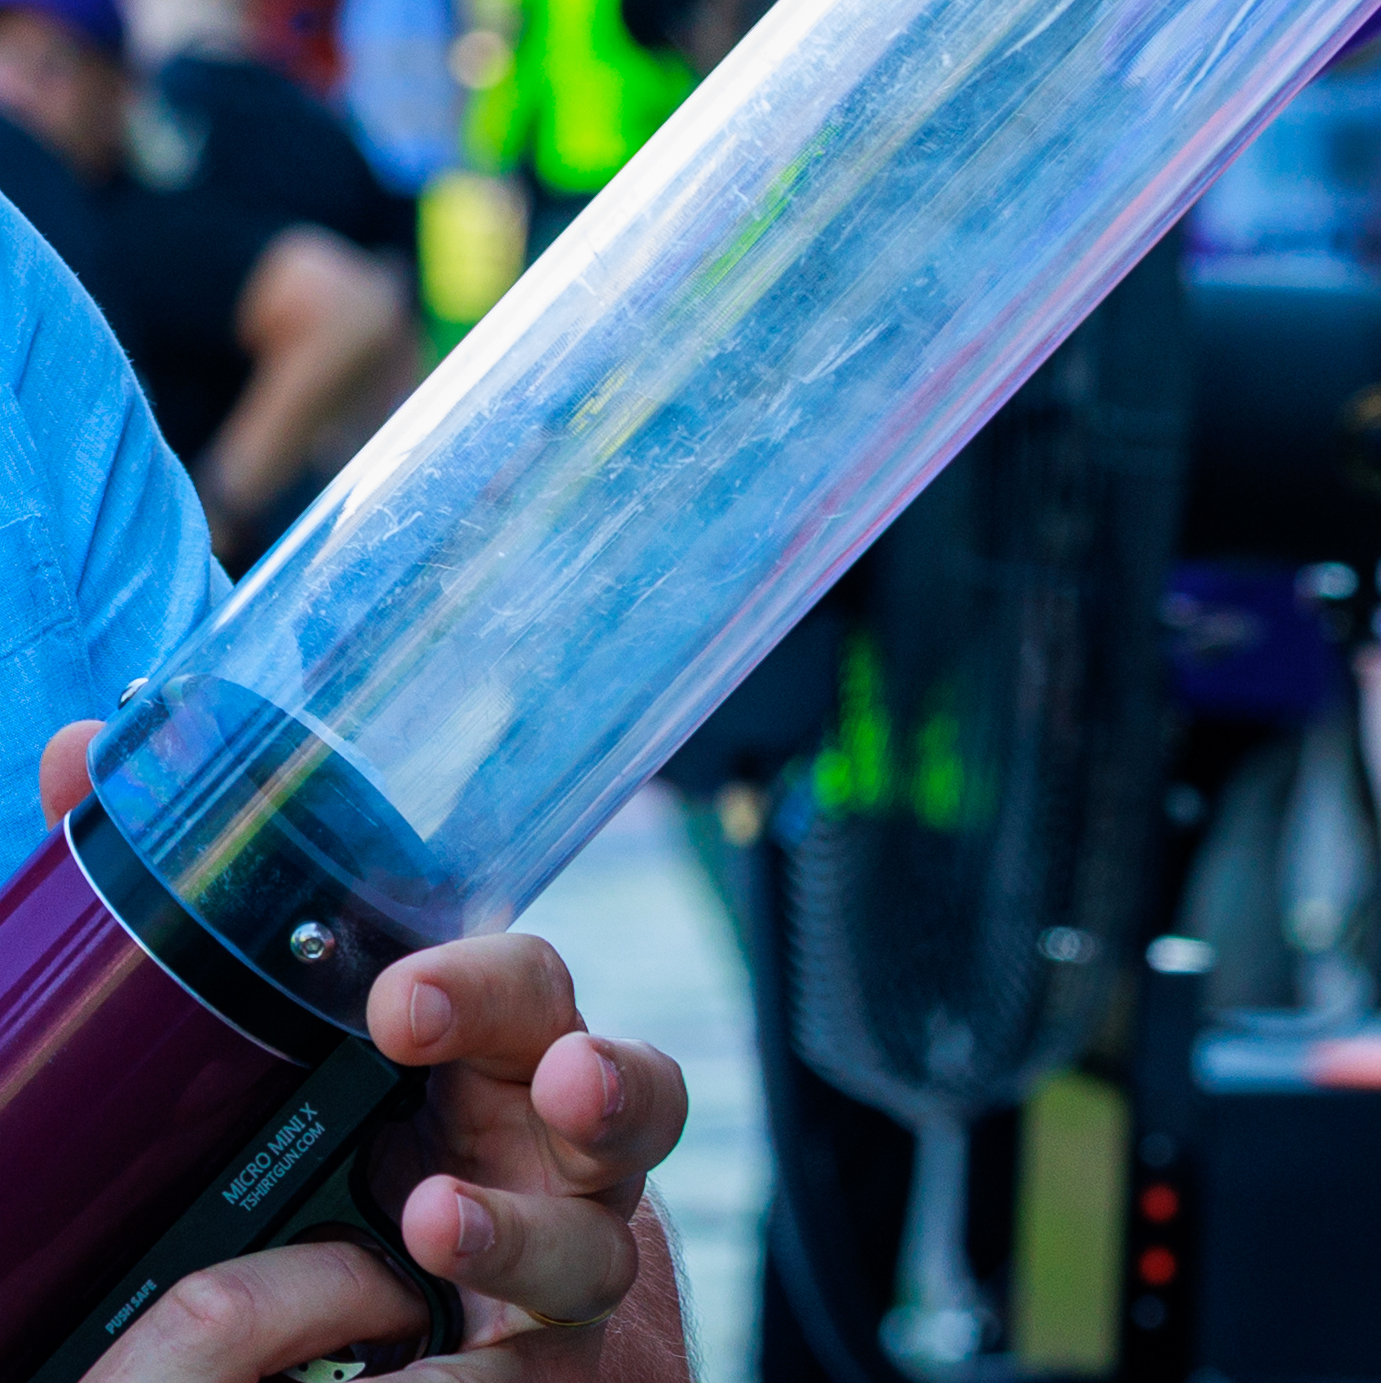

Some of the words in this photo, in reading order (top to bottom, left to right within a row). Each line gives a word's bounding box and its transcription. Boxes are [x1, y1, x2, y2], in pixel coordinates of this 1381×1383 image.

[221, 1152, 271, 1205] MICRO
[267, 1115, 306, 1156] MINI
[299, 1102, 318, 1121] X
[239, 1121, 325, 1211] TSHIRTGUN.COM
[105, 1303, 134, 1335] PUSH
[130, 1279, 157, 1308] SAFE
